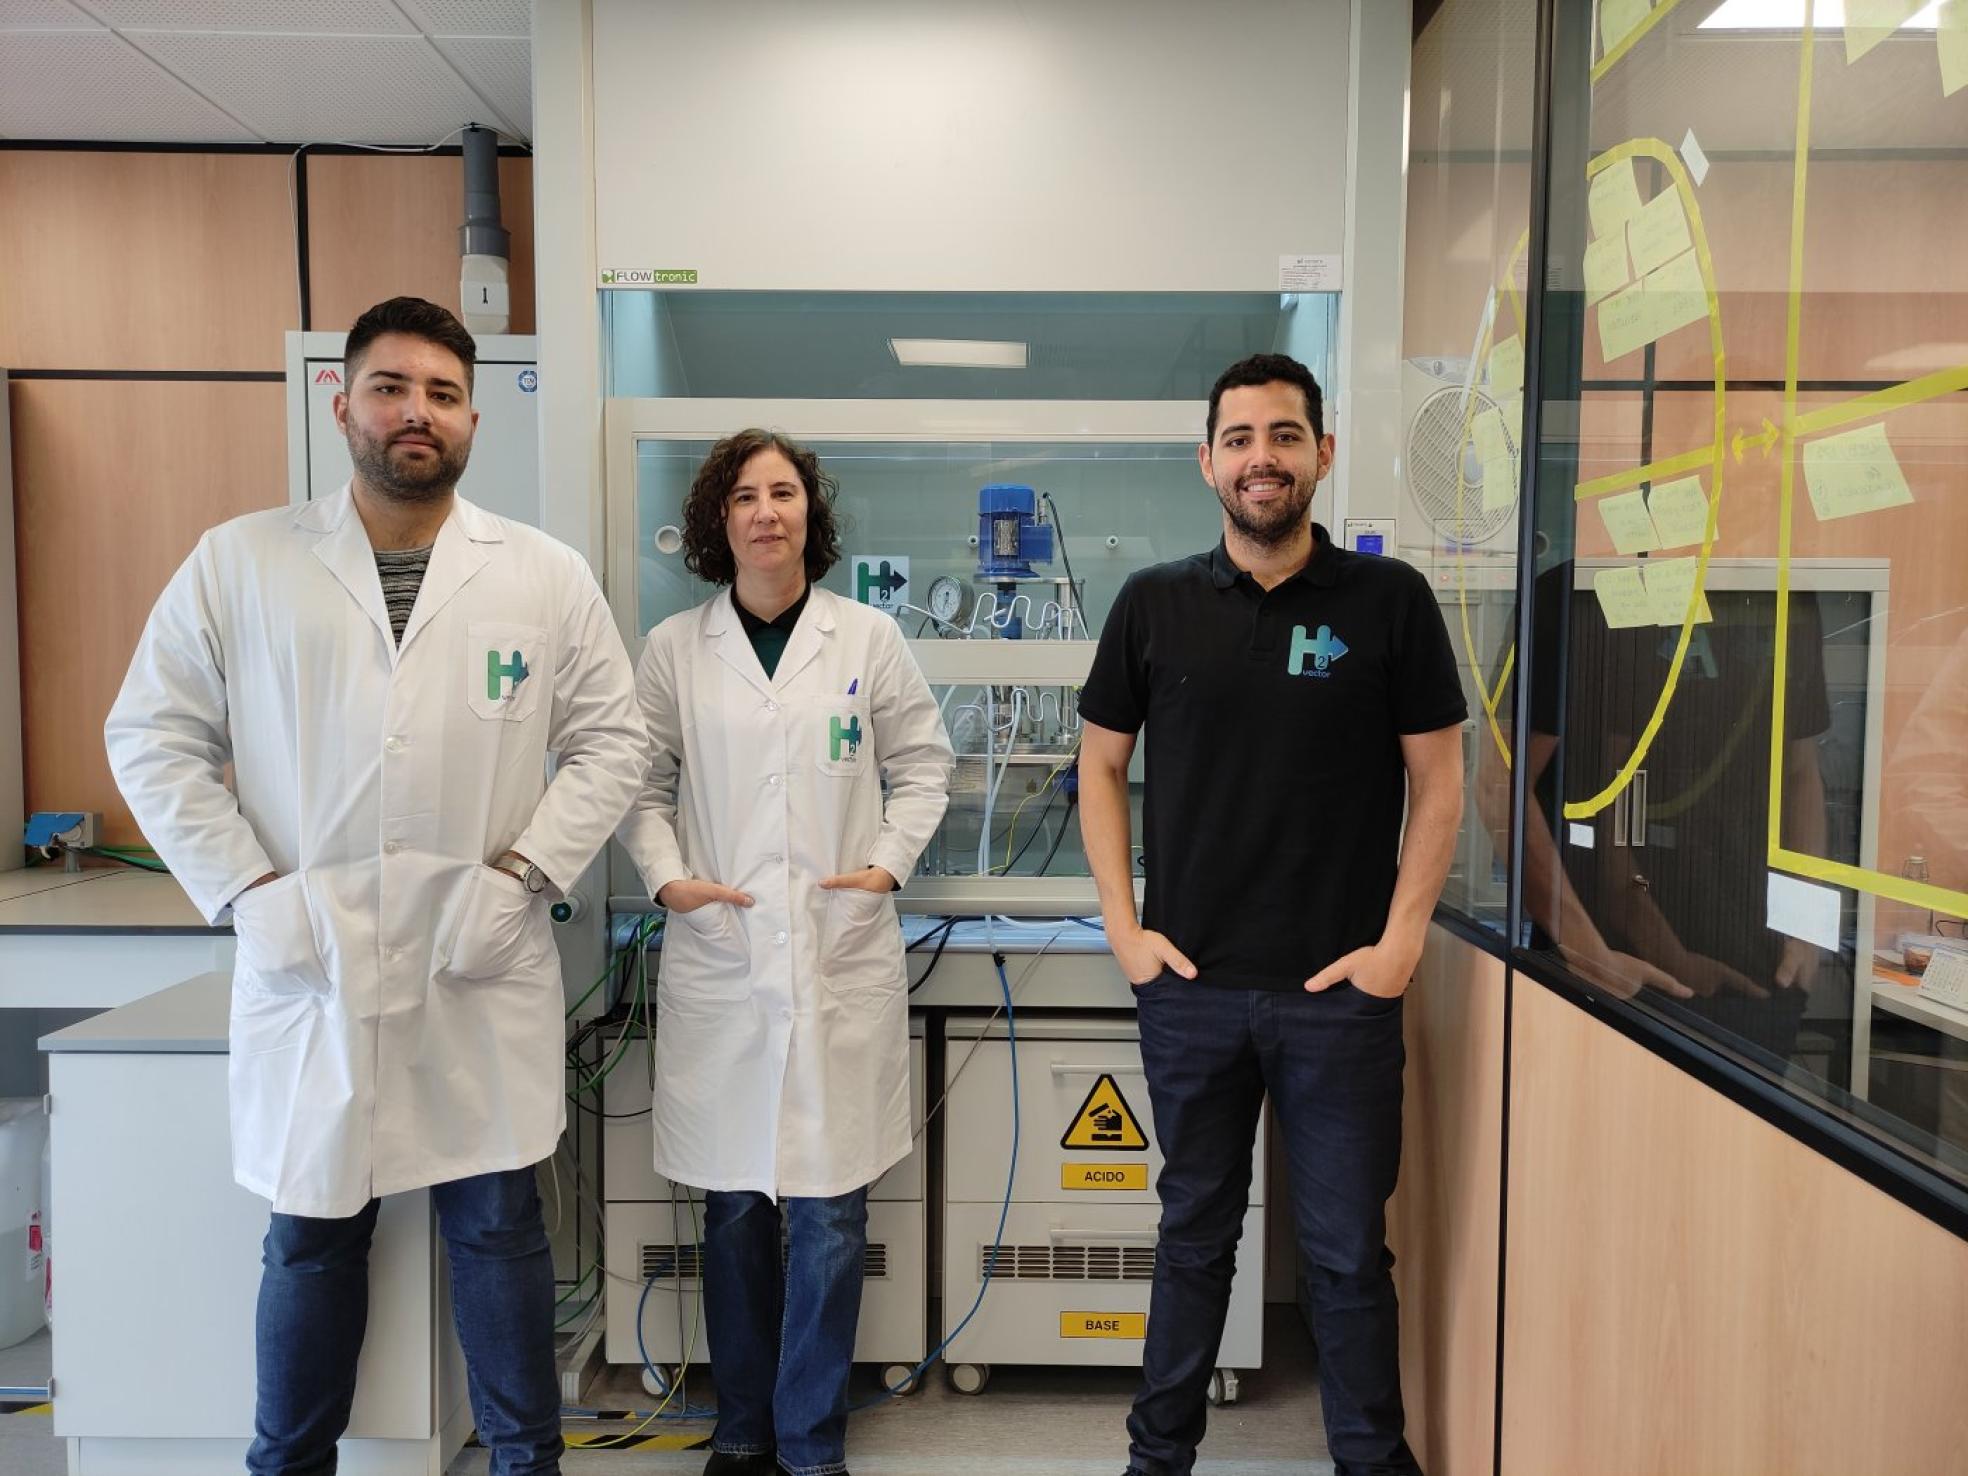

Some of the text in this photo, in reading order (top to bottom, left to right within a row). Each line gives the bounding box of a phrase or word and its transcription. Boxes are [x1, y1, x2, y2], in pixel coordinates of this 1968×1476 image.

[1303, 669, 1331, 678] vector
[1085, 1171, 1125, 1182] ACIDO
[1086, 1320, 1120, 1331] BASE
